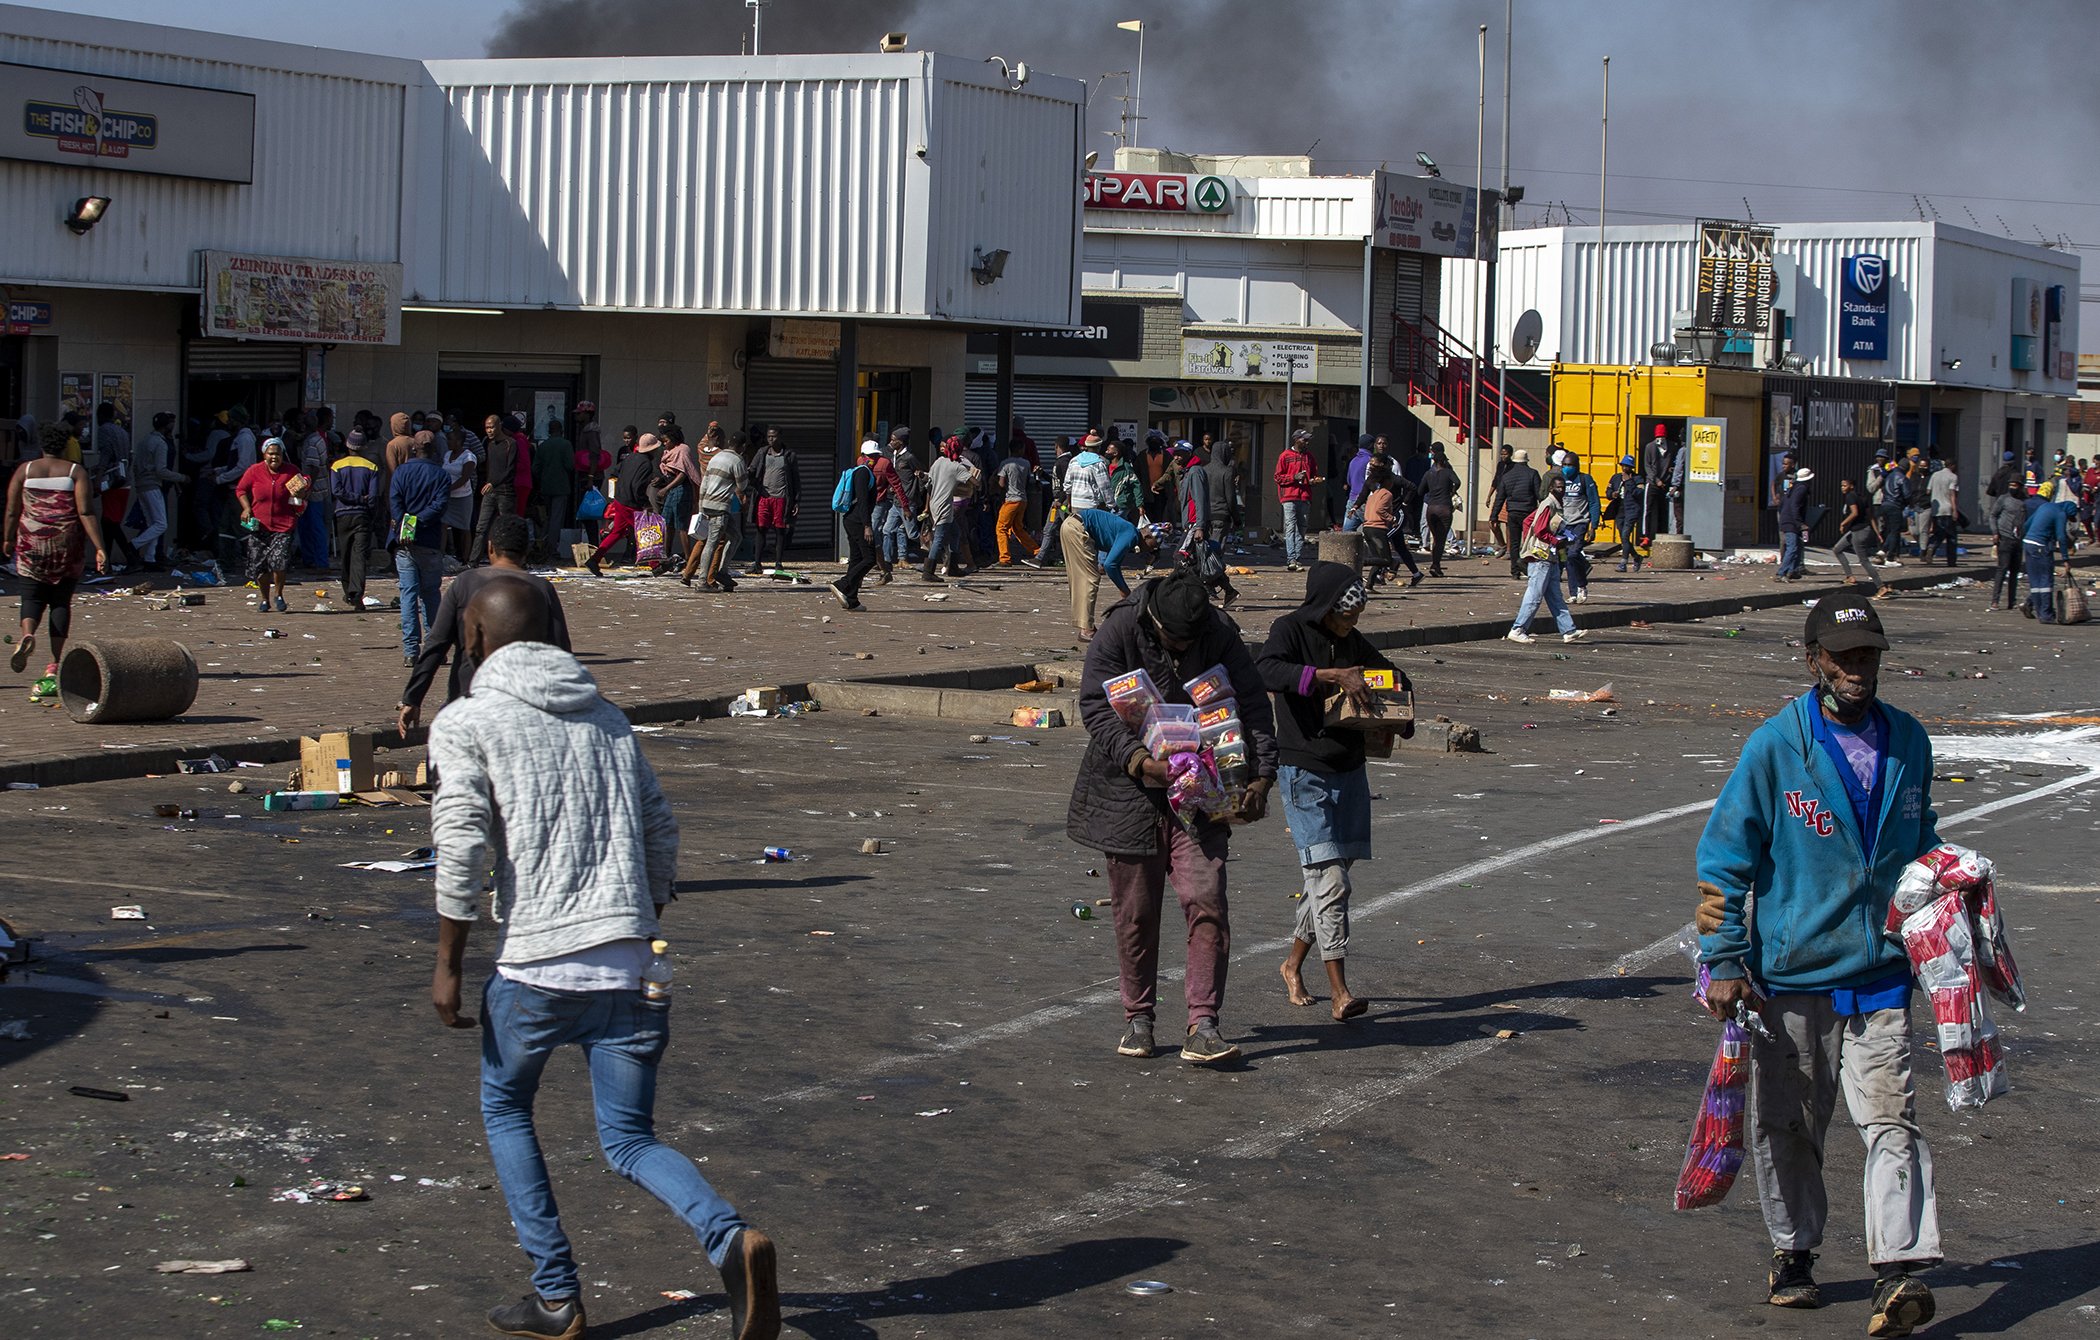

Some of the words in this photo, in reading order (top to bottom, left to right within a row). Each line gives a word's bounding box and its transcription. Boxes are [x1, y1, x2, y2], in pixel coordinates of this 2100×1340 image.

[31, 112, 49, 127] THE
[50, 111, 85, 134] FISH
[85, 114, 98, 136] &
[103, 117, 138, 139] CHIP
[138, 125, 152, 138] CO
[1084, 178, 1185, 205] PAR
[1390, 193, 1423, 220] TeraByte
[1700, 260, 1714, 293] PIZZA
[1747, 265, 1758, 298] PIZZA
[1712, 260, 1727, 324] DEBONAIRS
[1733, 262, 1748, 324] DEBONAIRS
[1757, 266, 1772, 327] DEBONAIRS
[11, 305, 37, 321] CHIP
[1843, 301, 1886, 314] Standard
[1851, 315, 1877, 327] Bank
[1276, 353, 1309, 361] PLUMBING
[1852, 341, 1874, 351] ATM
[1188, 363, 1235, 375] Hardware
[1792, 405, 1803, 425] ZA
[1809, 401, 1854, 438] DEBONAIRS
[1857, 402, 1880, 438] PIZZA
[1694, 430, 1718, 443] SAFETY
[1784, 790, 1834, 837] NYC
